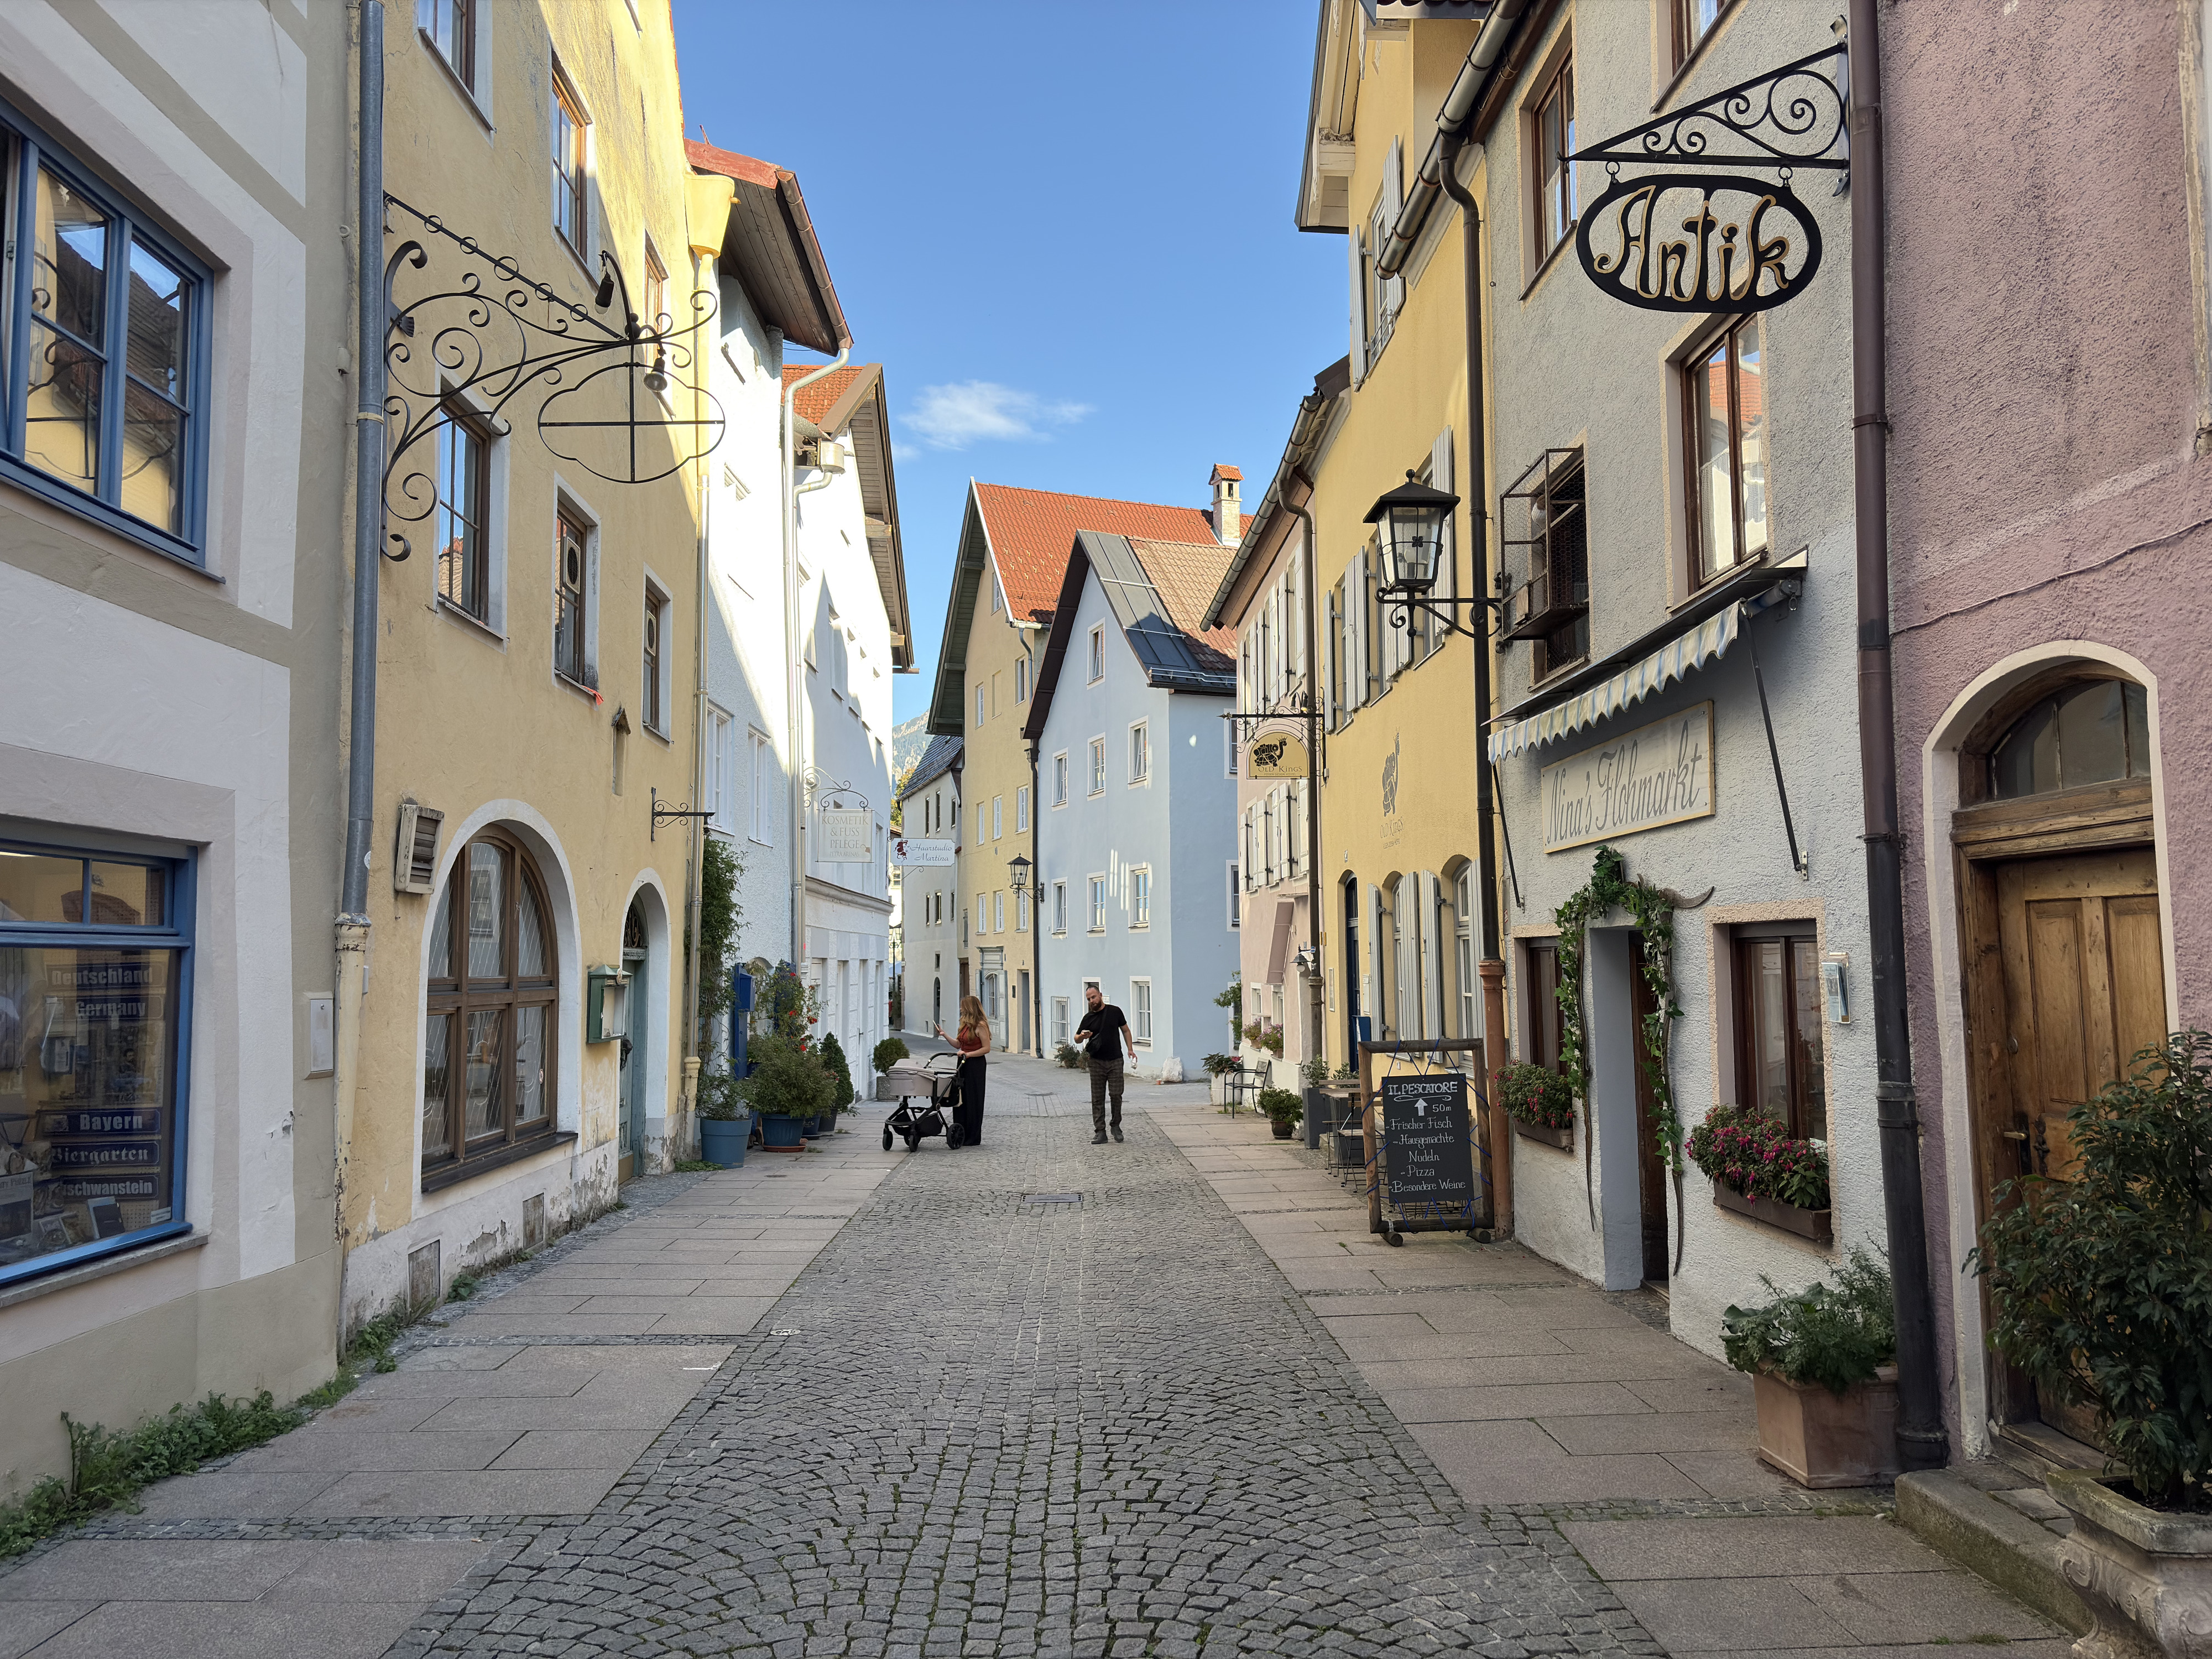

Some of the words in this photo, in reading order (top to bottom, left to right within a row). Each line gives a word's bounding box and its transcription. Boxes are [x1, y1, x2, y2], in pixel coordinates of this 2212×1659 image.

[1593, 185, 1790, 302] Antik
[1547, 768, 1593, 844] Nina's
[1596, 719, 1702, 831] Flohmarkt
[822, 816, 869, 825] KOSMETIK
[830, 827, 837, 836] &
[840, 827, 859, 836] FUSS
[830, 839, 859, 848] PFLEGE
[910, 843, 952, 852] Haarstudio
[914, 853, 949, 862] Martina
[51, 968, 153, 985] Deutschland
[76, 1001, 145, 1017] Germany
[1401, 1081, 1458, 1094] PESCATORE
[1432, 1104, 1452, 1113] 50m
[80, 1114, 143, 1131] Bayern
[1390, 1118, 1425, 1130] Frischer
[1427, 1116, 1452, 1128] Fisch
[1399, 1132, 1454, 1149] Hausgemachte
[1408, 1149, 1440, 1162] Nudeln
[1406, 1165, 1434, 1177] Pizza
[1391, 1181, 1437, 1193] Besondere
[1438, 1178, 1466, 1190] Weine
